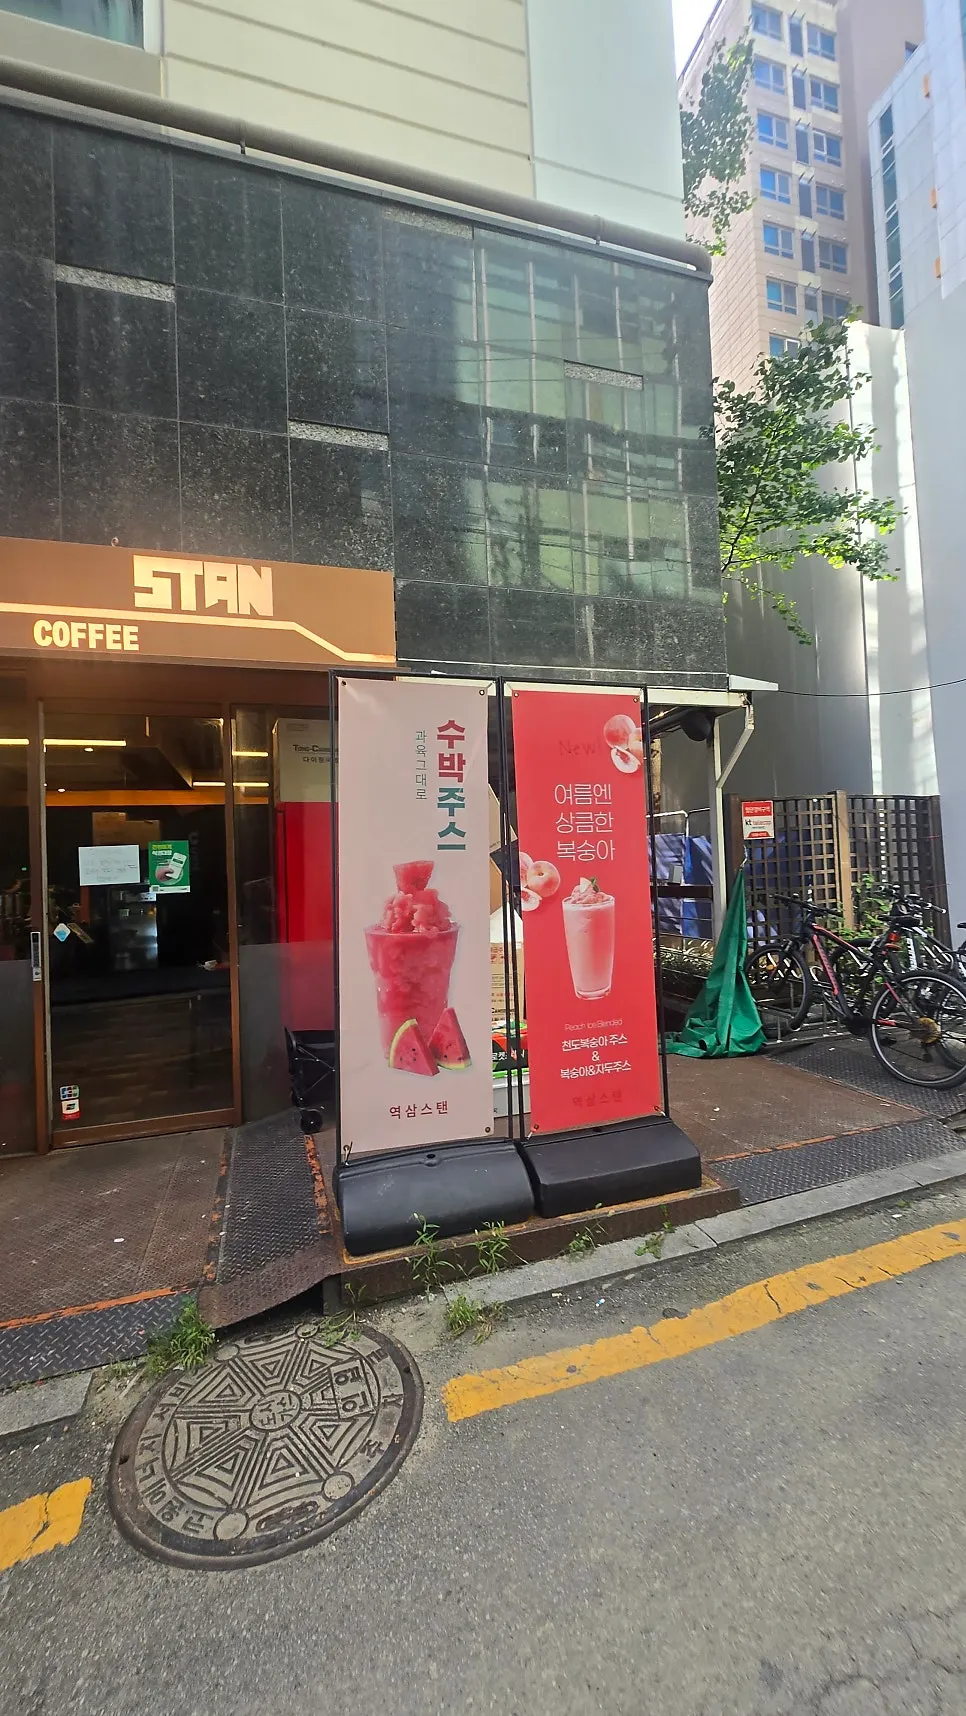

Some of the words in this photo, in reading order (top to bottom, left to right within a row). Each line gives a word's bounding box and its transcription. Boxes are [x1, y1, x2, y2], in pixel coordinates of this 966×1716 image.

[133, 555, 274, 617] STAN
[33, 619, 139, 651] COFFEE
[415, 730, 427, 800] 과육그대로
[437, 720, 466, 850] 수박주스
[554, 783, 612, 806] 여름엔
[555, 811, 614, 834] 상큼한
[557, 839, 615, 862] 복숭아
[564, 1023, 586, 1031] Peach
[597, 1018, 623, 1028] Blended
[562, 1036, 608, 1052] 천도복숭아
[609, 1034, 628, 1046] 주스
[591, 1050, 600, 1061] &
[560, 1060, 632, 1079] 복숭아&자두주스
[389, 1100, 448, 1120] 역삼스탠
